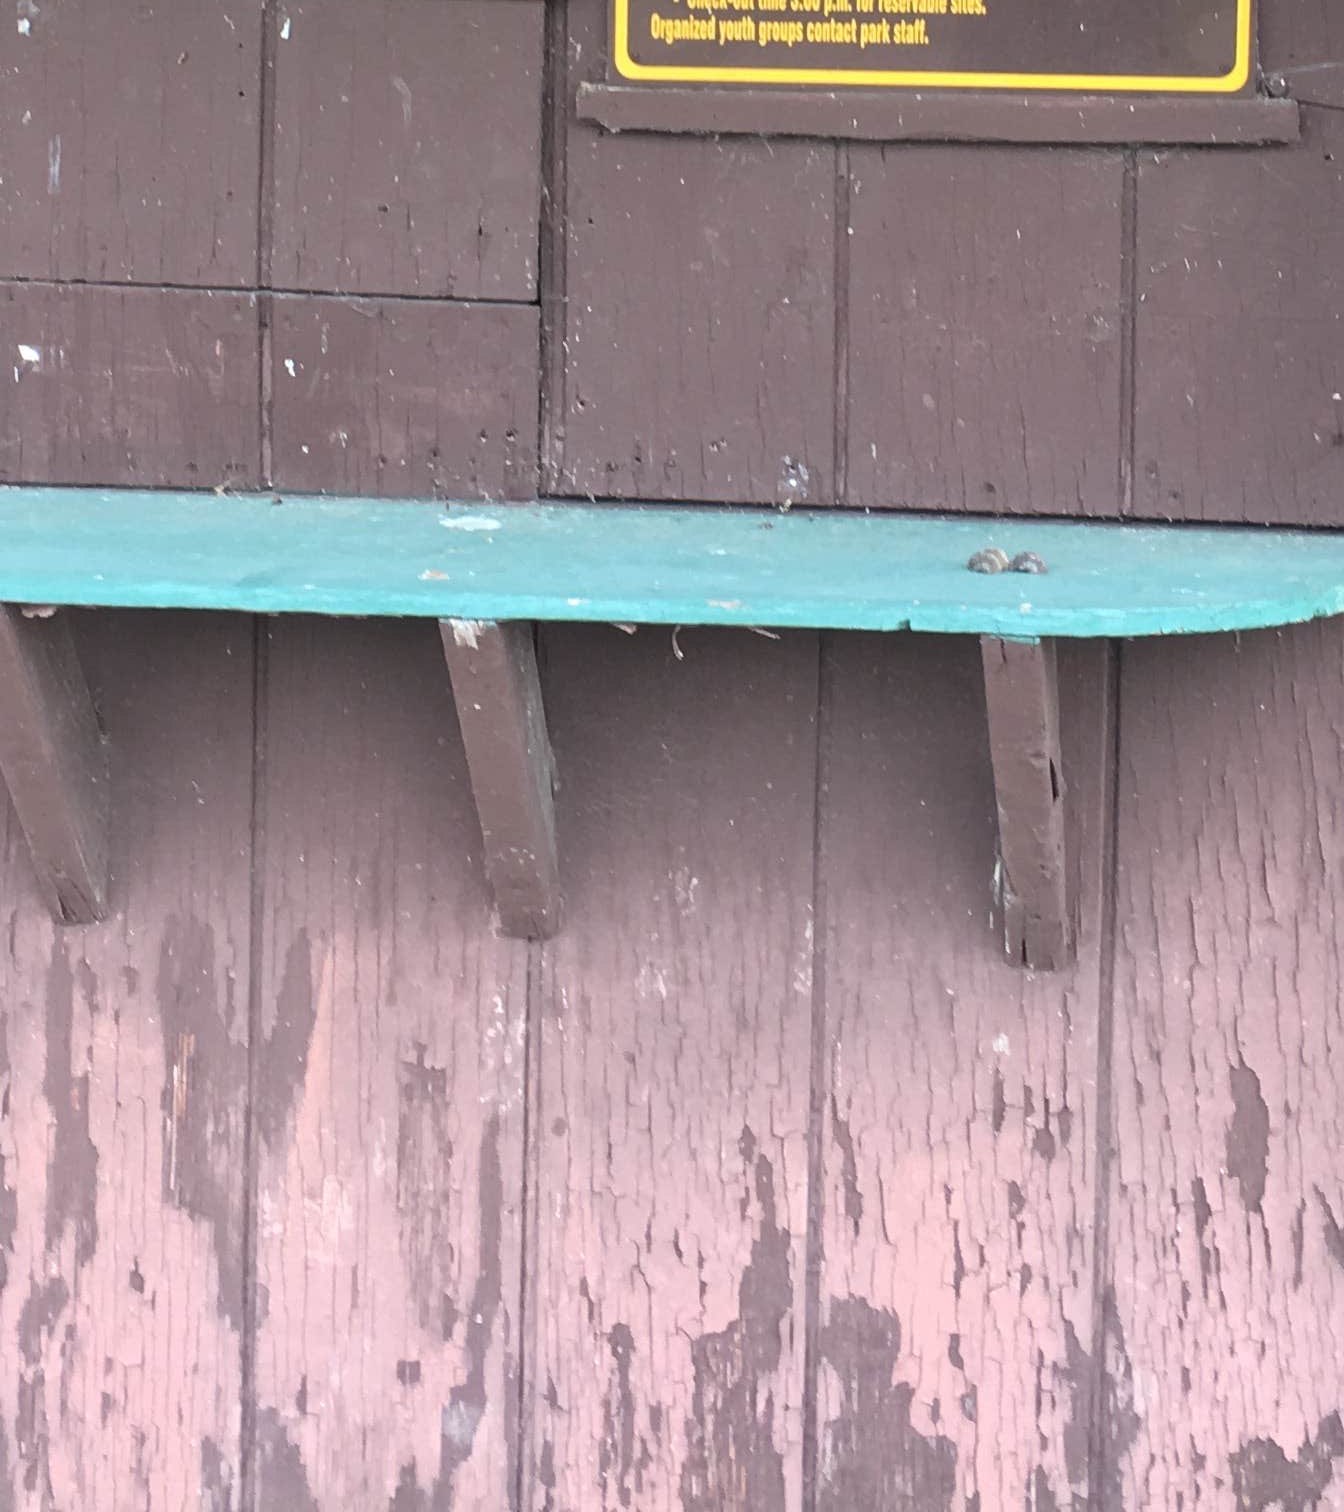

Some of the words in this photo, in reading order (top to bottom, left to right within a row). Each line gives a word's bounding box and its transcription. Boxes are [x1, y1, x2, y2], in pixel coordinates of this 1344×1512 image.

[650, 13, 716, 45] Organized
[718, 15, 756, 46] youth
[758, 20, 804, 47] groups
[806, 18, 857, 44] contact
[860, 17, 891, 49] park
